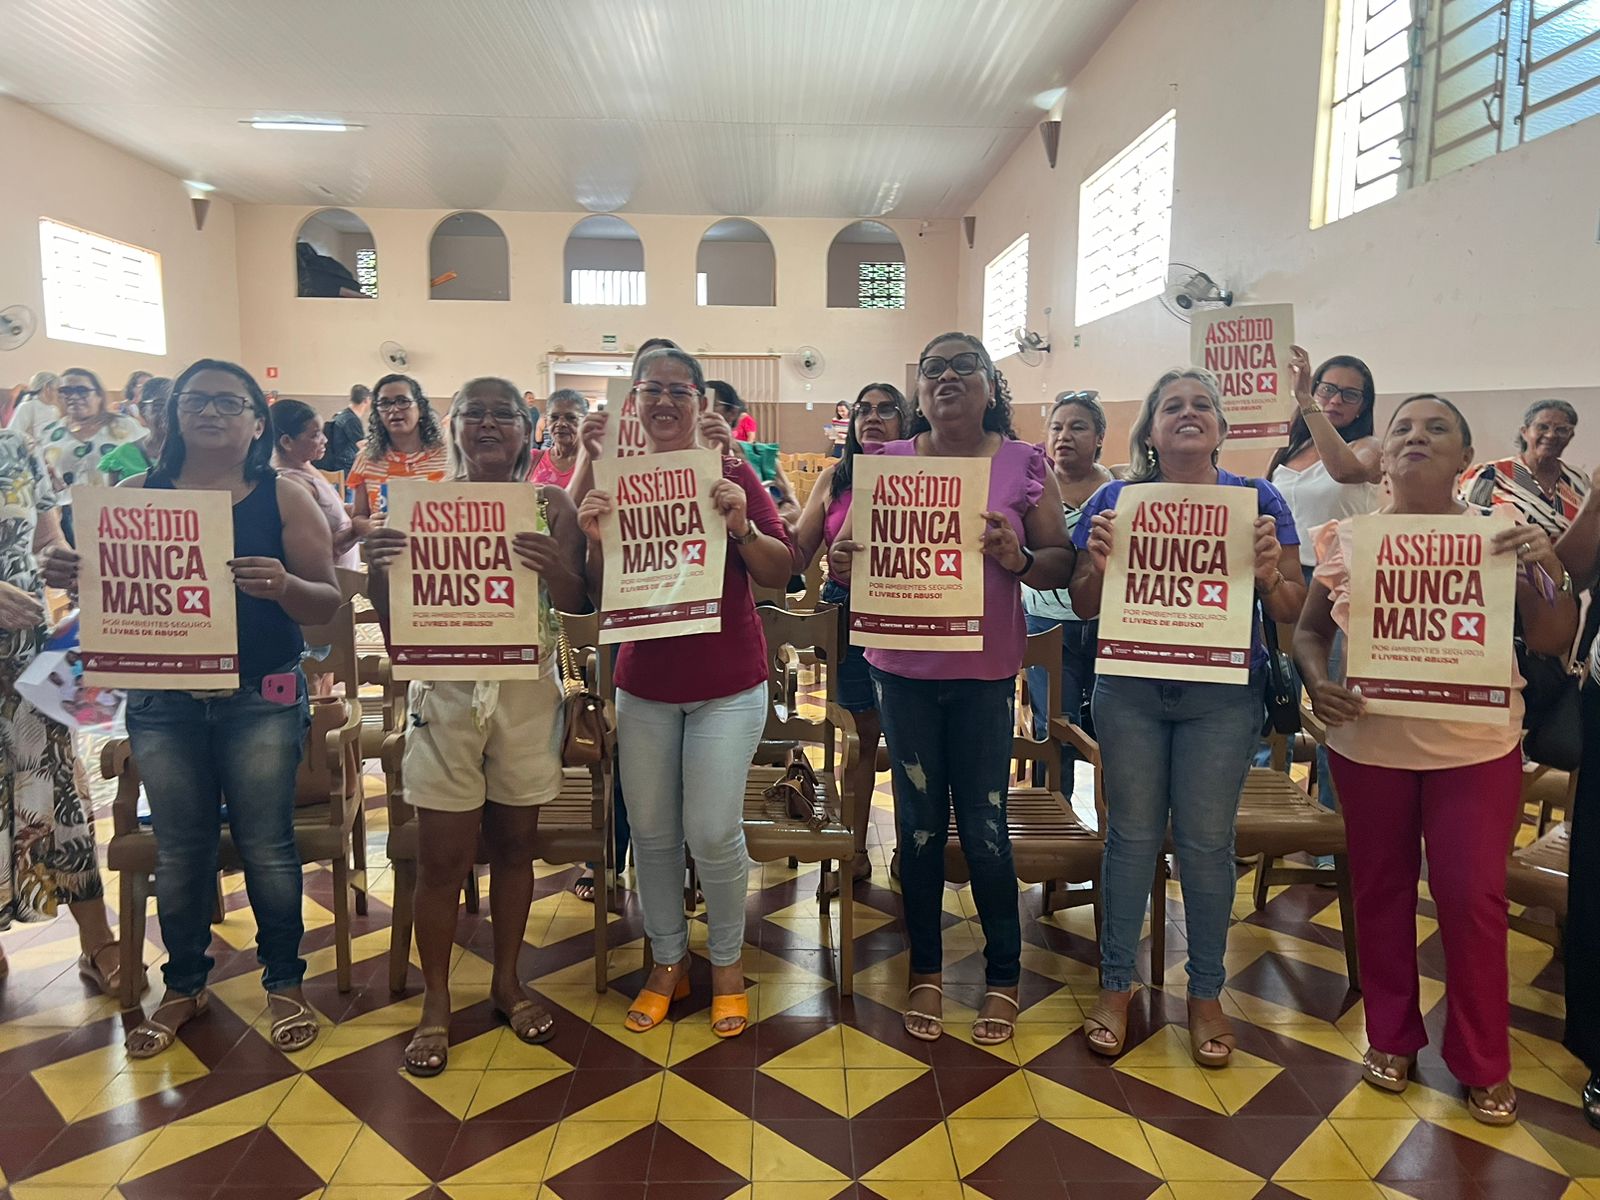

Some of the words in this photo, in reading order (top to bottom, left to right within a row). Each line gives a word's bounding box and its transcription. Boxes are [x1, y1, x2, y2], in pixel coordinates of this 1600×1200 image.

[1205, 315, 1273, 345] ASSÉDIO
[1205, 343, 1277, 371] NUNCA
[1219, 372, 1253, 397] AIS
[616, 467, 697, 505] ASSÉDIO
[872, 471, 961, 508] ASSÉDIO
[98, 503, 199, 542] ASSÉDIO
[410, 496, 505, 533] ASSÉDIO
[618, 501, 705, 541] NUNCA
[871, 509, 961, 544] NUNCA
[1132, 498, 1229, 537] ASSÉDIO
[99, 542, 208, 580] NUNCA
[410, 536, 512, 571] NUNCA
[622, 540, 678, 574] MAIS
[870, 546, 931, 579] MAIS
[1128, 536, 1229, 576] NUNCA
[1377, 529, 1482, 566] ASSÉDIO
[102, 580, 173, 616] MAIS
[412, 573, 480, 607] MAIS
[875, 591, 901, 599] LIVRES
[885, 583, 927, 591] AMBIENTES
[1125, 573, 1194, 608] MAIS
[1374, 569, 1485, 607] NUNCA
[1372, 607, 1447, 641] MAIS
